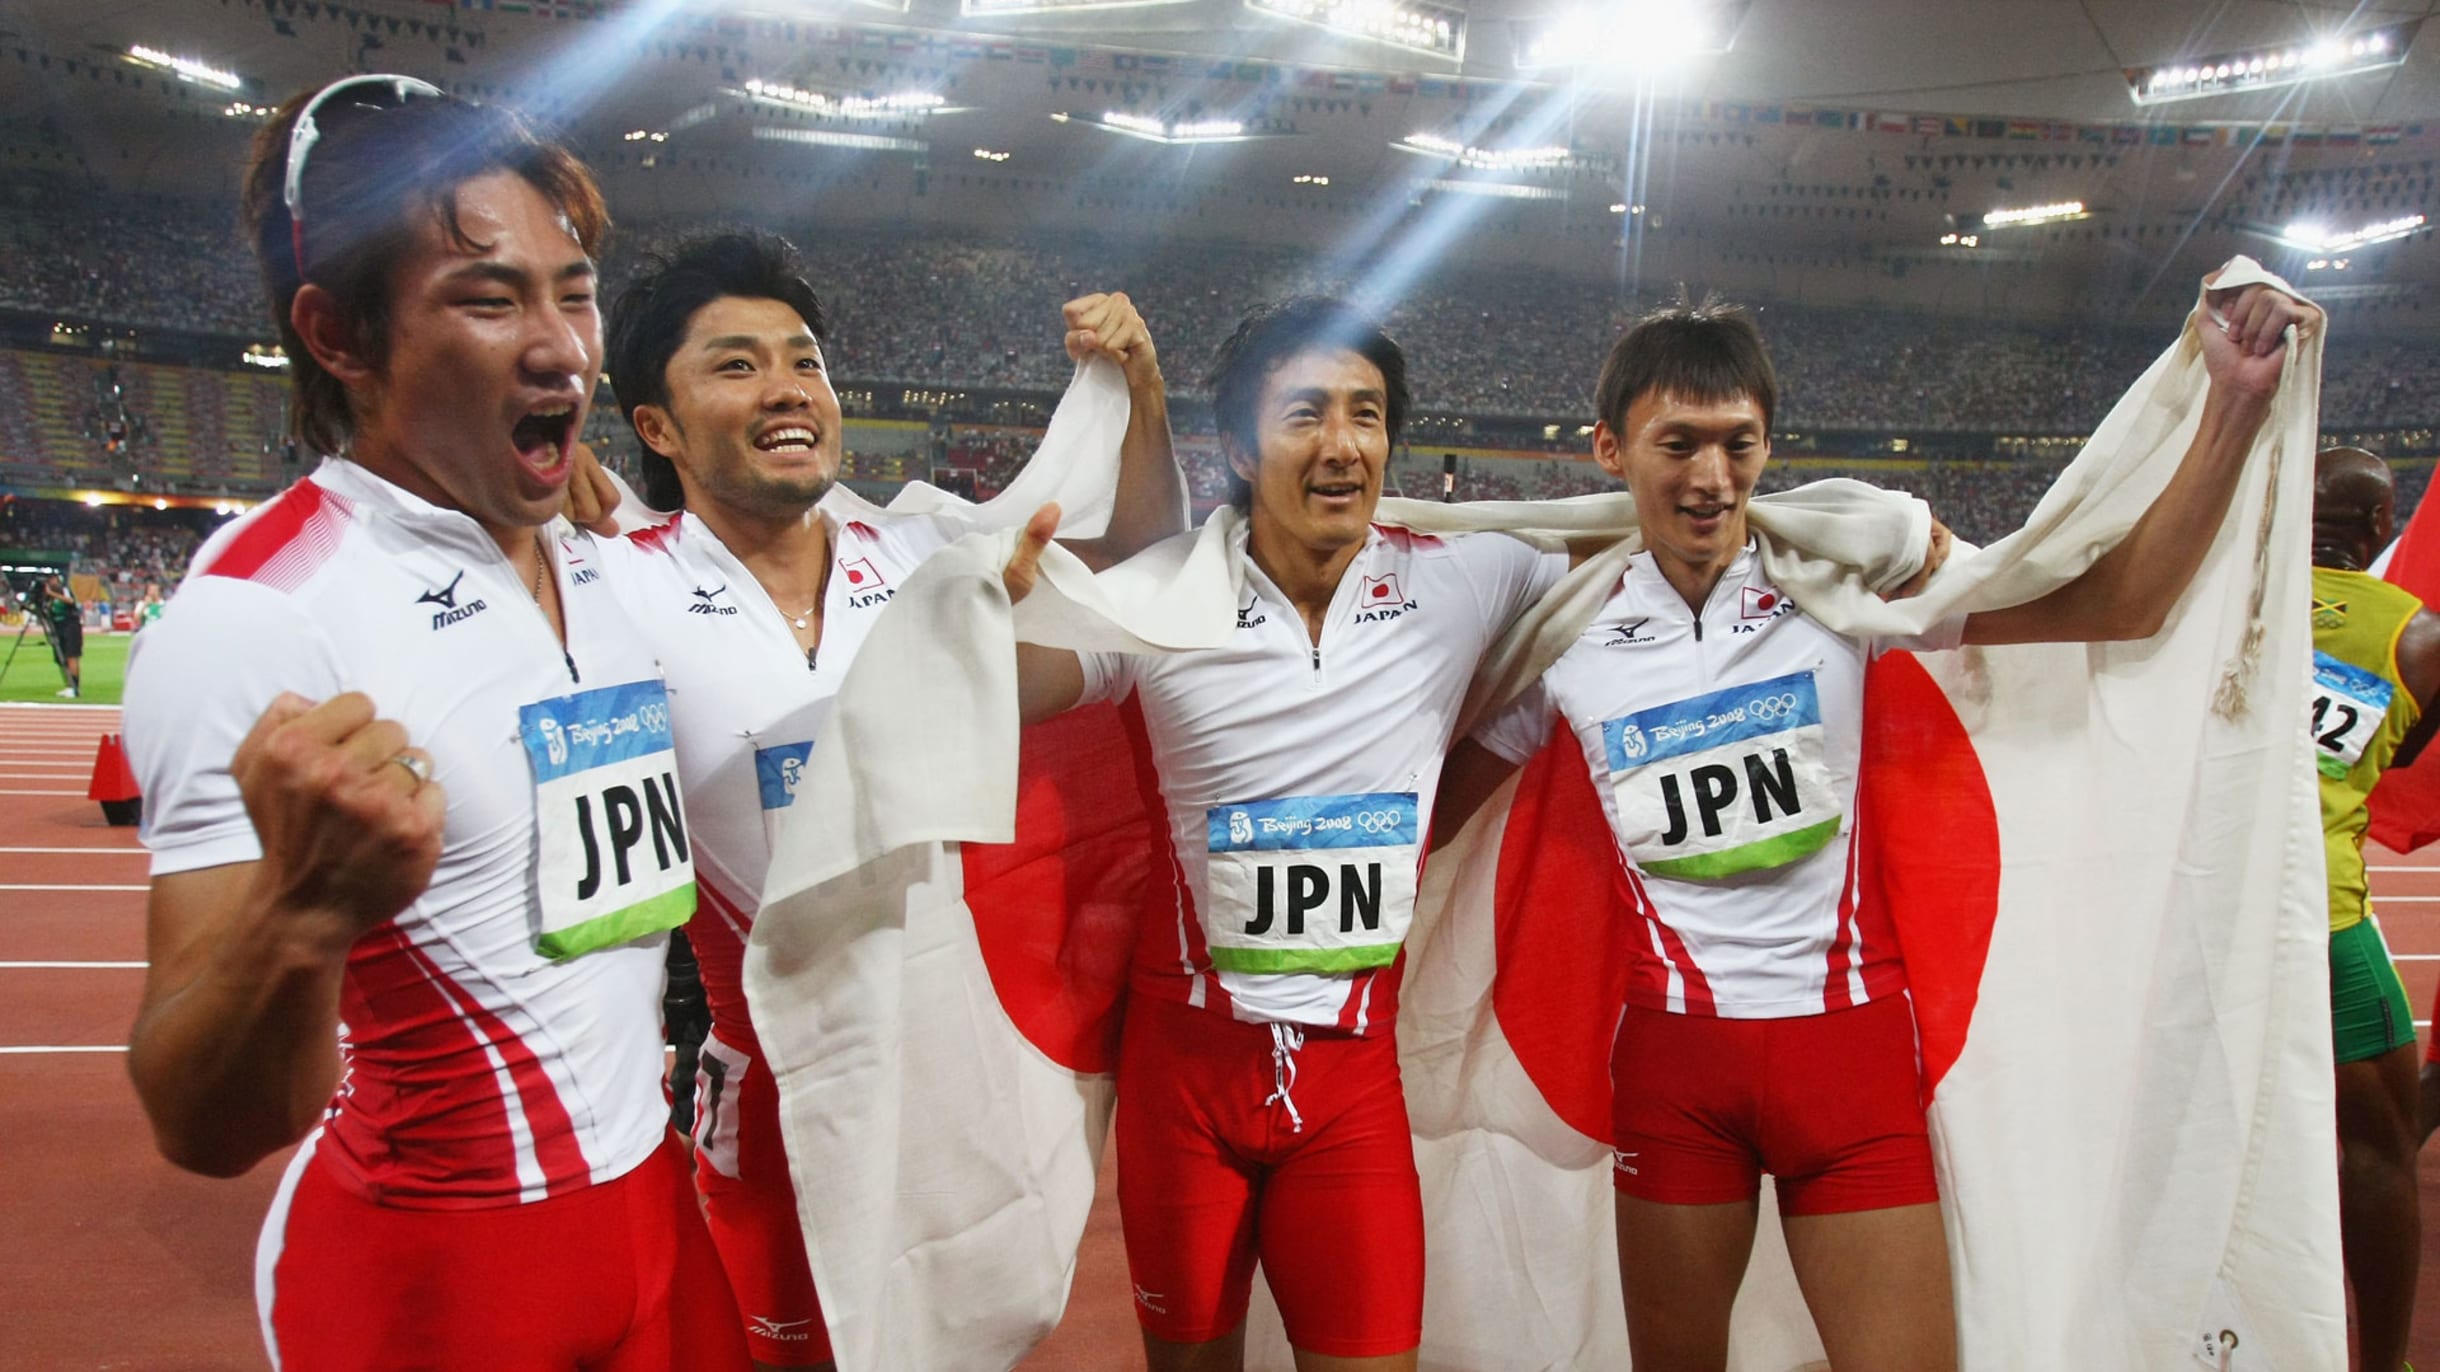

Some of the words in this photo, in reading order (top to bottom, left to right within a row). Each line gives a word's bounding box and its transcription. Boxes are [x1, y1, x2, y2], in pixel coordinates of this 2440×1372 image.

[1354, 599, 1418, 624] JAPAN
[1648, 719, 1705, 742] Beijing
[1706, 707, 1746, 728] 2008
[1660, 748, 1802, 846] JPN
[575, 772, 688, 900] JPN
[1257, 815, 1312, 836] Beijing
[1314, 815, 1352, 830] 2008
[1245, 863, 1381, 936] JPN
